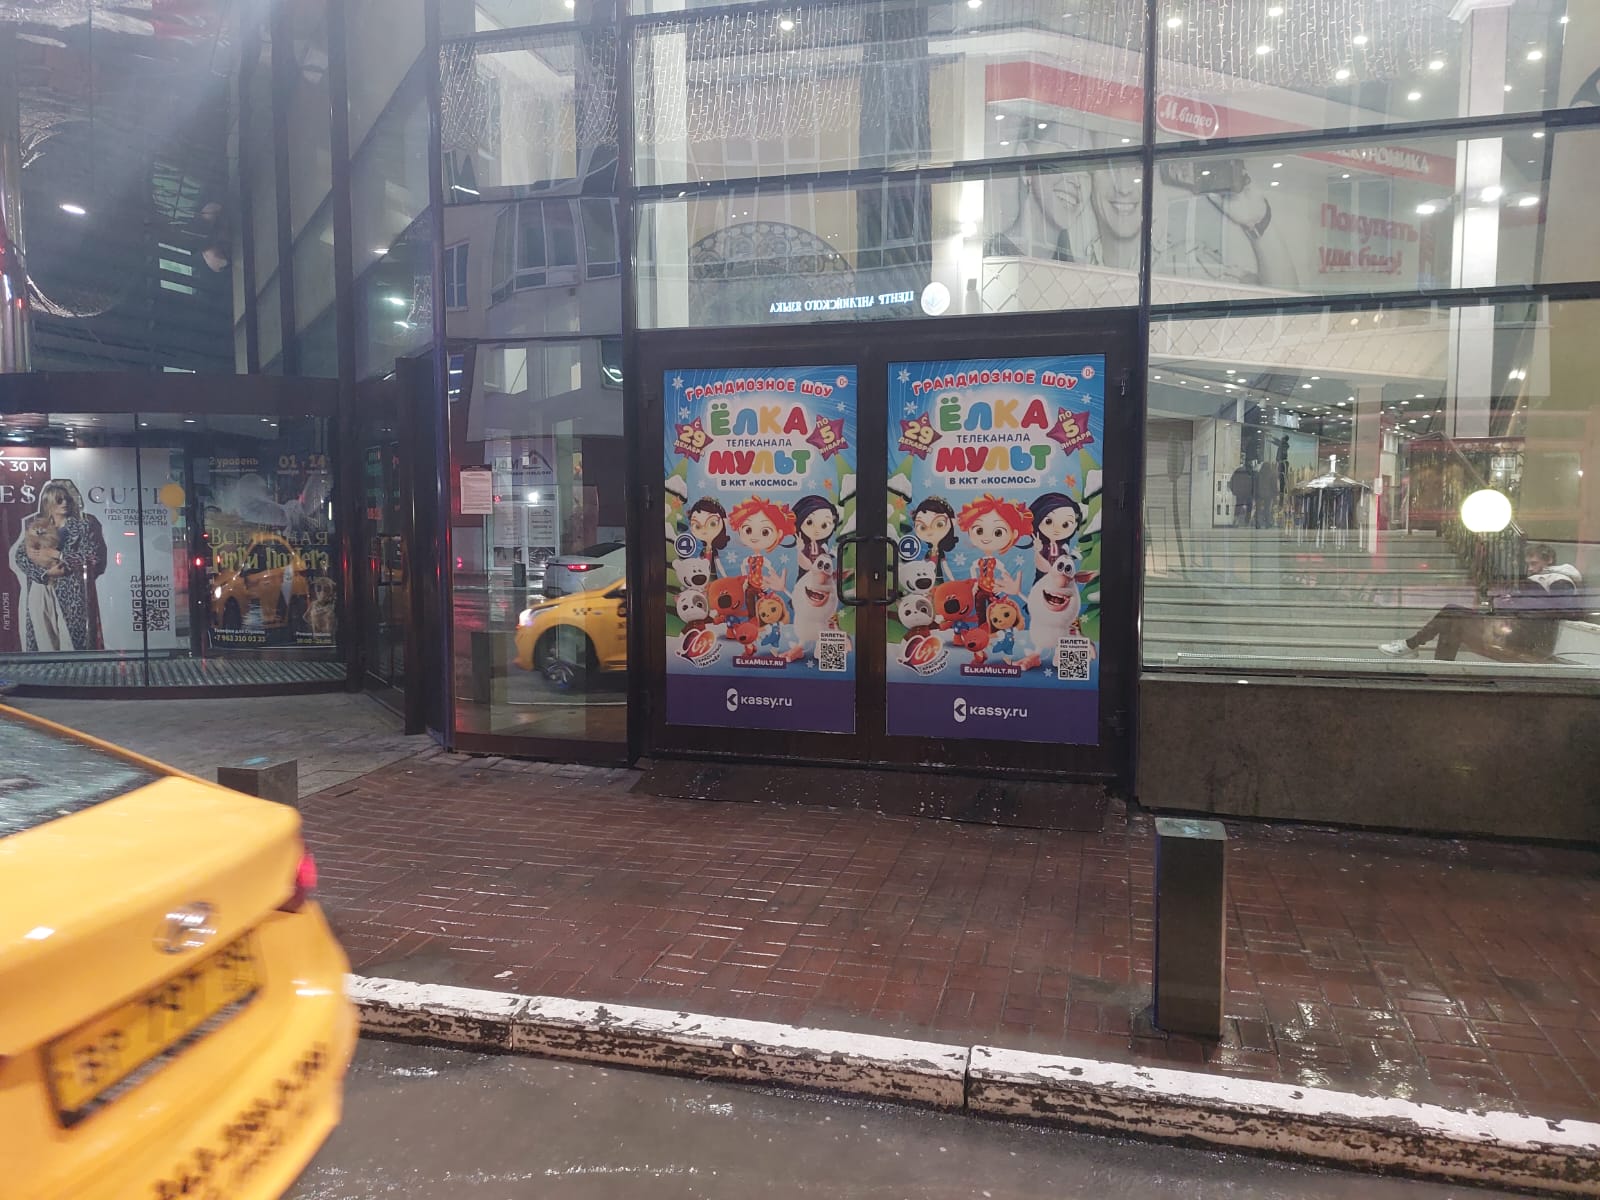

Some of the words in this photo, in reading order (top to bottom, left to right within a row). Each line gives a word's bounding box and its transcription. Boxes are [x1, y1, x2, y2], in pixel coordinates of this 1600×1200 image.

[686, 379, 796, 400] ГРАНДИОЗНОЕ
[801, 384, 833, 397] ШОУ
[913, 371, 1035, 395] ГРАНДИОЗНОЕ
[1042, 375, 1078, 388] ШОУ
[711, 403, 809, 436] ЁЛКА
[940, 396, 1049, 432] ЁЛКА
[680, 425, 706, 448] 29
[820, 425, 835, 444] 5
[904, 421, 935, 445] 29
[956, 433, 1031, 443] ТЕЛЕКАНАЛА
[1062, 418, 1080, 438] 5
[726, 438, 793, 447] ТЕЛЕКАНАЛА
[1062, 430, 1092, 450] ЯНВАРЯ
[9, 461, 29, 472] 30
[208, 456, 216, 466] 2
[708, 450, 812, 475] МУЛЬТ
[936, 444, 1052, 472] МУЛЬТ
[729, 479, 747, 487] ККТ
[749, 479, 798, 487] «КОСМОС»
[958, 476, 979, 485] ККТ
[981, 476, 1036, 484] «КОСМОС»
[741, 695, 793, 709] kassy.ru
[970, 706, 1028, 719] kassy.ru
